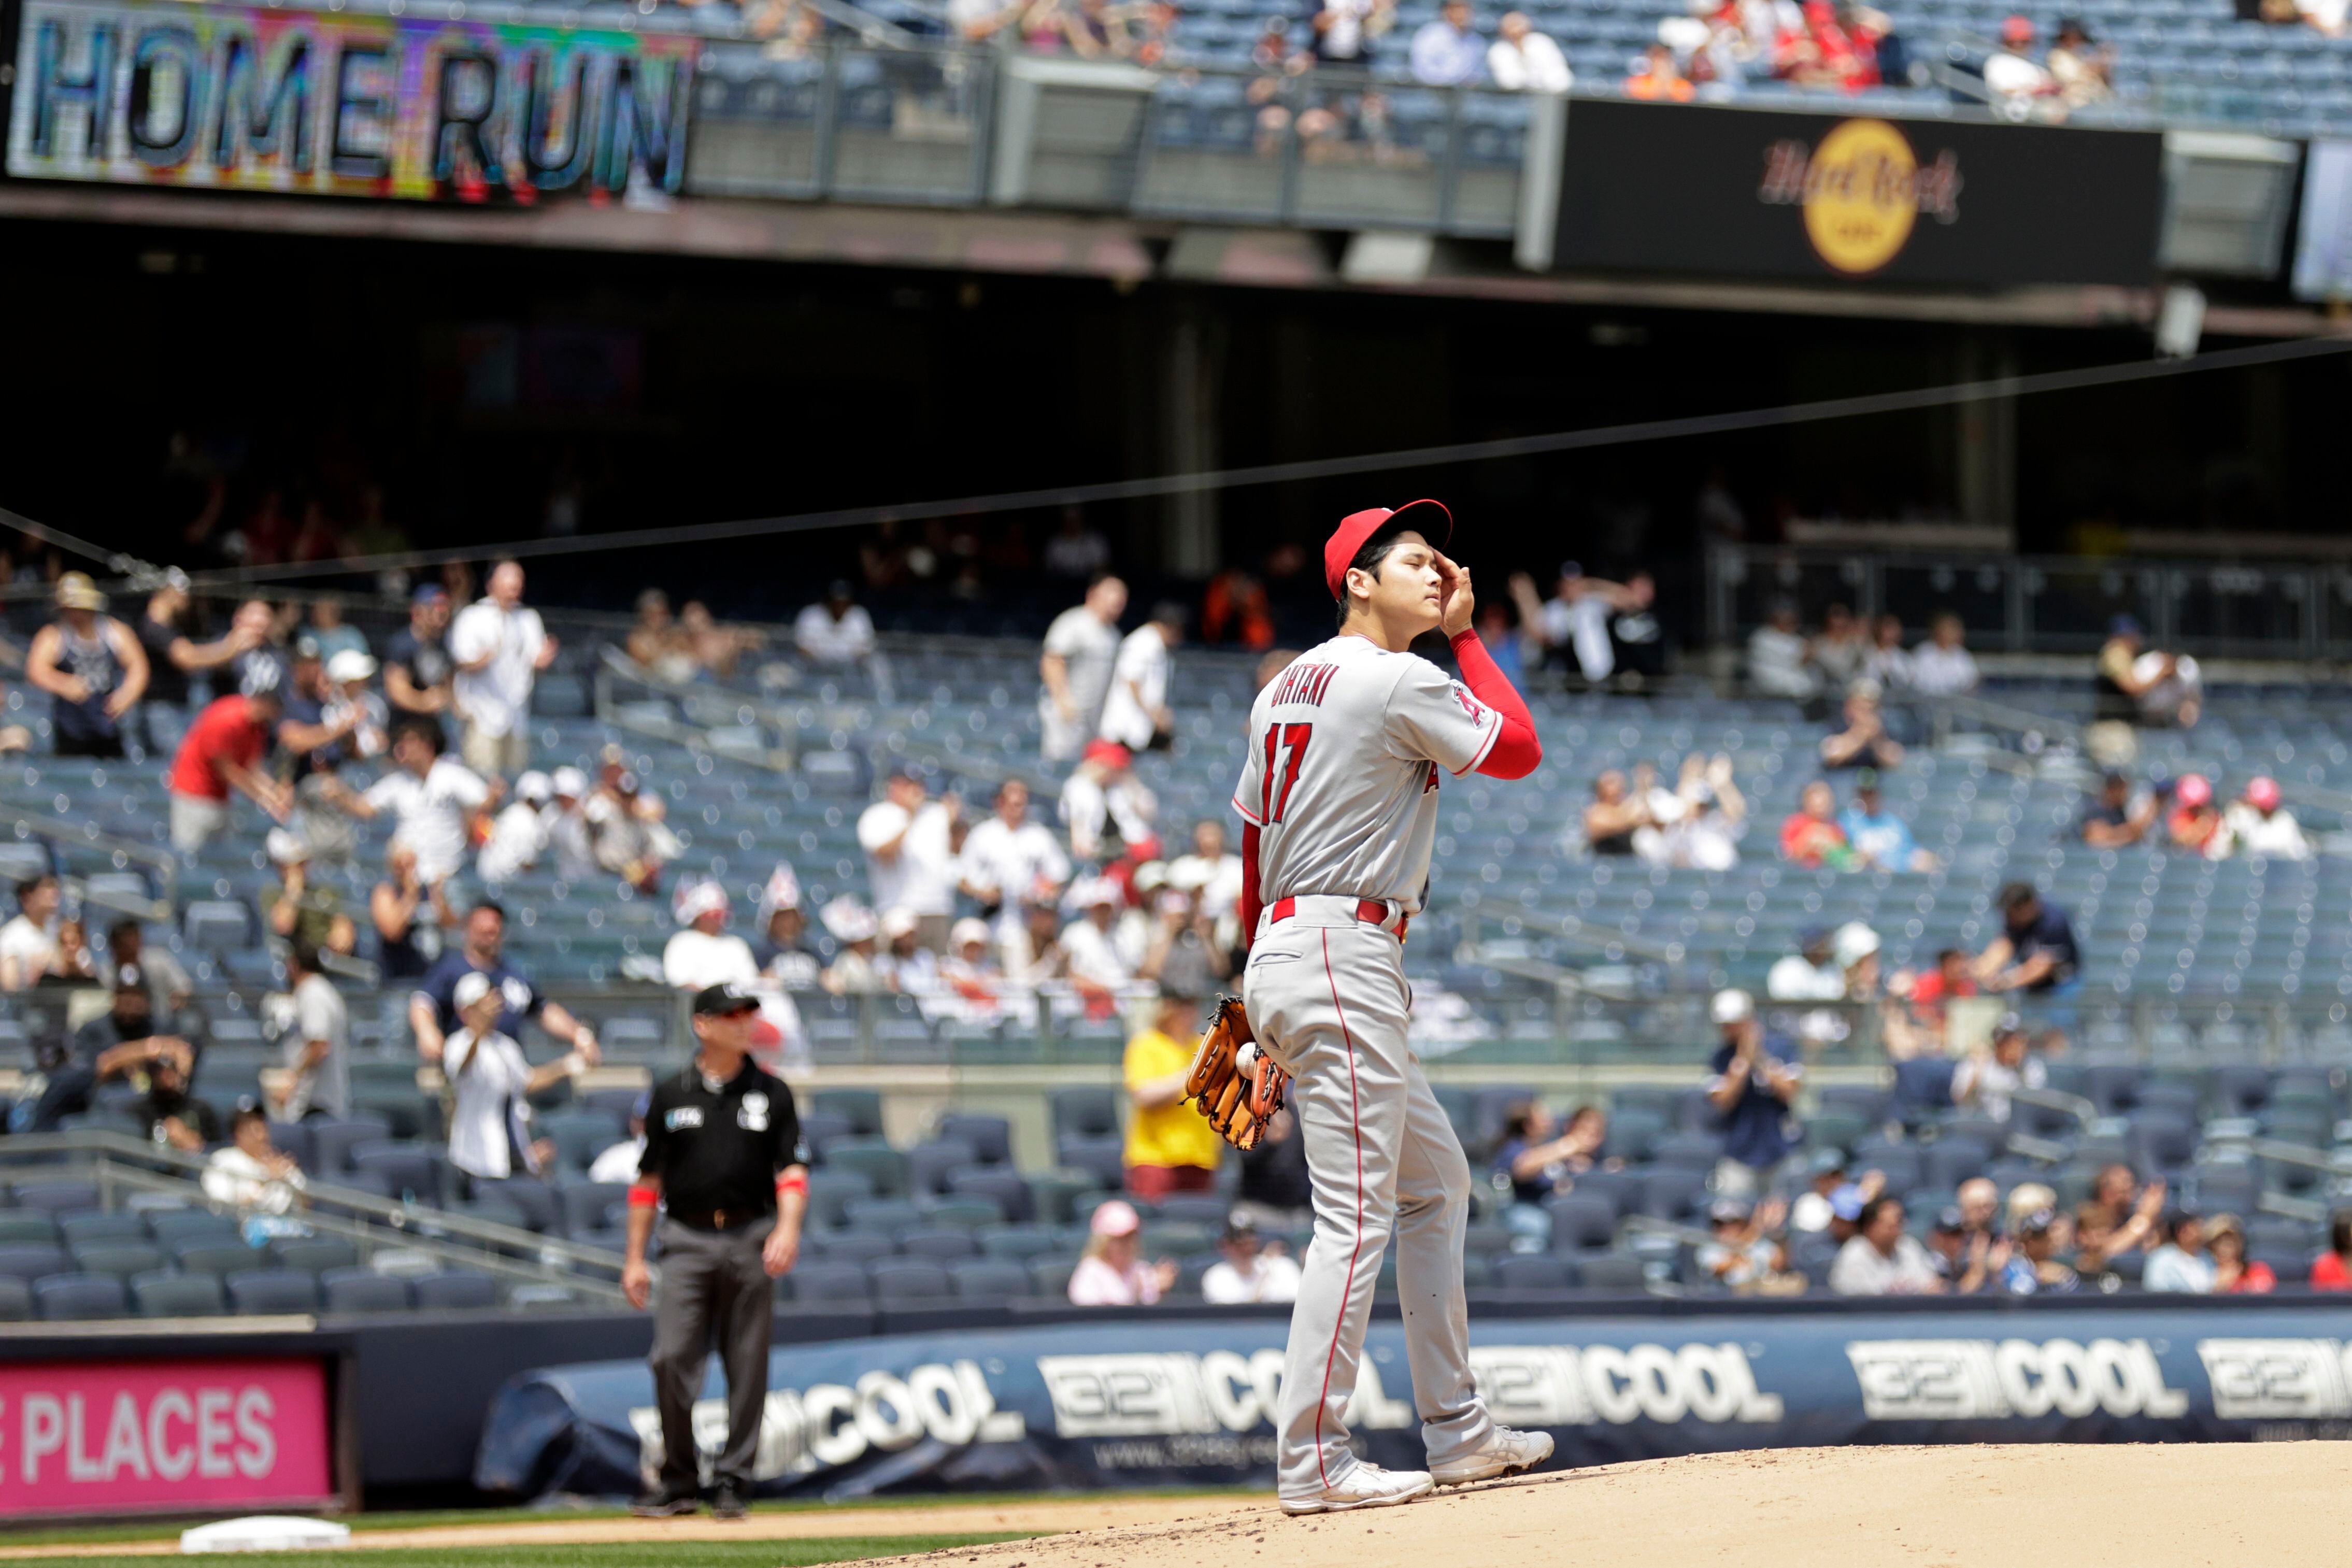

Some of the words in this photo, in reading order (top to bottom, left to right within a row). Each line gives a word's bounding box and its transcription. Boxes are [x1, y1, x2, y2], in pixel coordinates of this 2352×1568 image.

[31, 19, 396, 178] HOME
[431, 36, 688, 194] RUN
[1271, 663, 1340, 708] OHTANI
[1261, 722, 1313, 826] 17
[802, 1359, 1027, 1465] COOL
[1201, 1348, 1414, 1432] COL
[1583, 1342, 1785, 1425] COOL
[1999, 1338, 2190, 1419] COOL
[21, 1385, 278, 1485] PLACES
